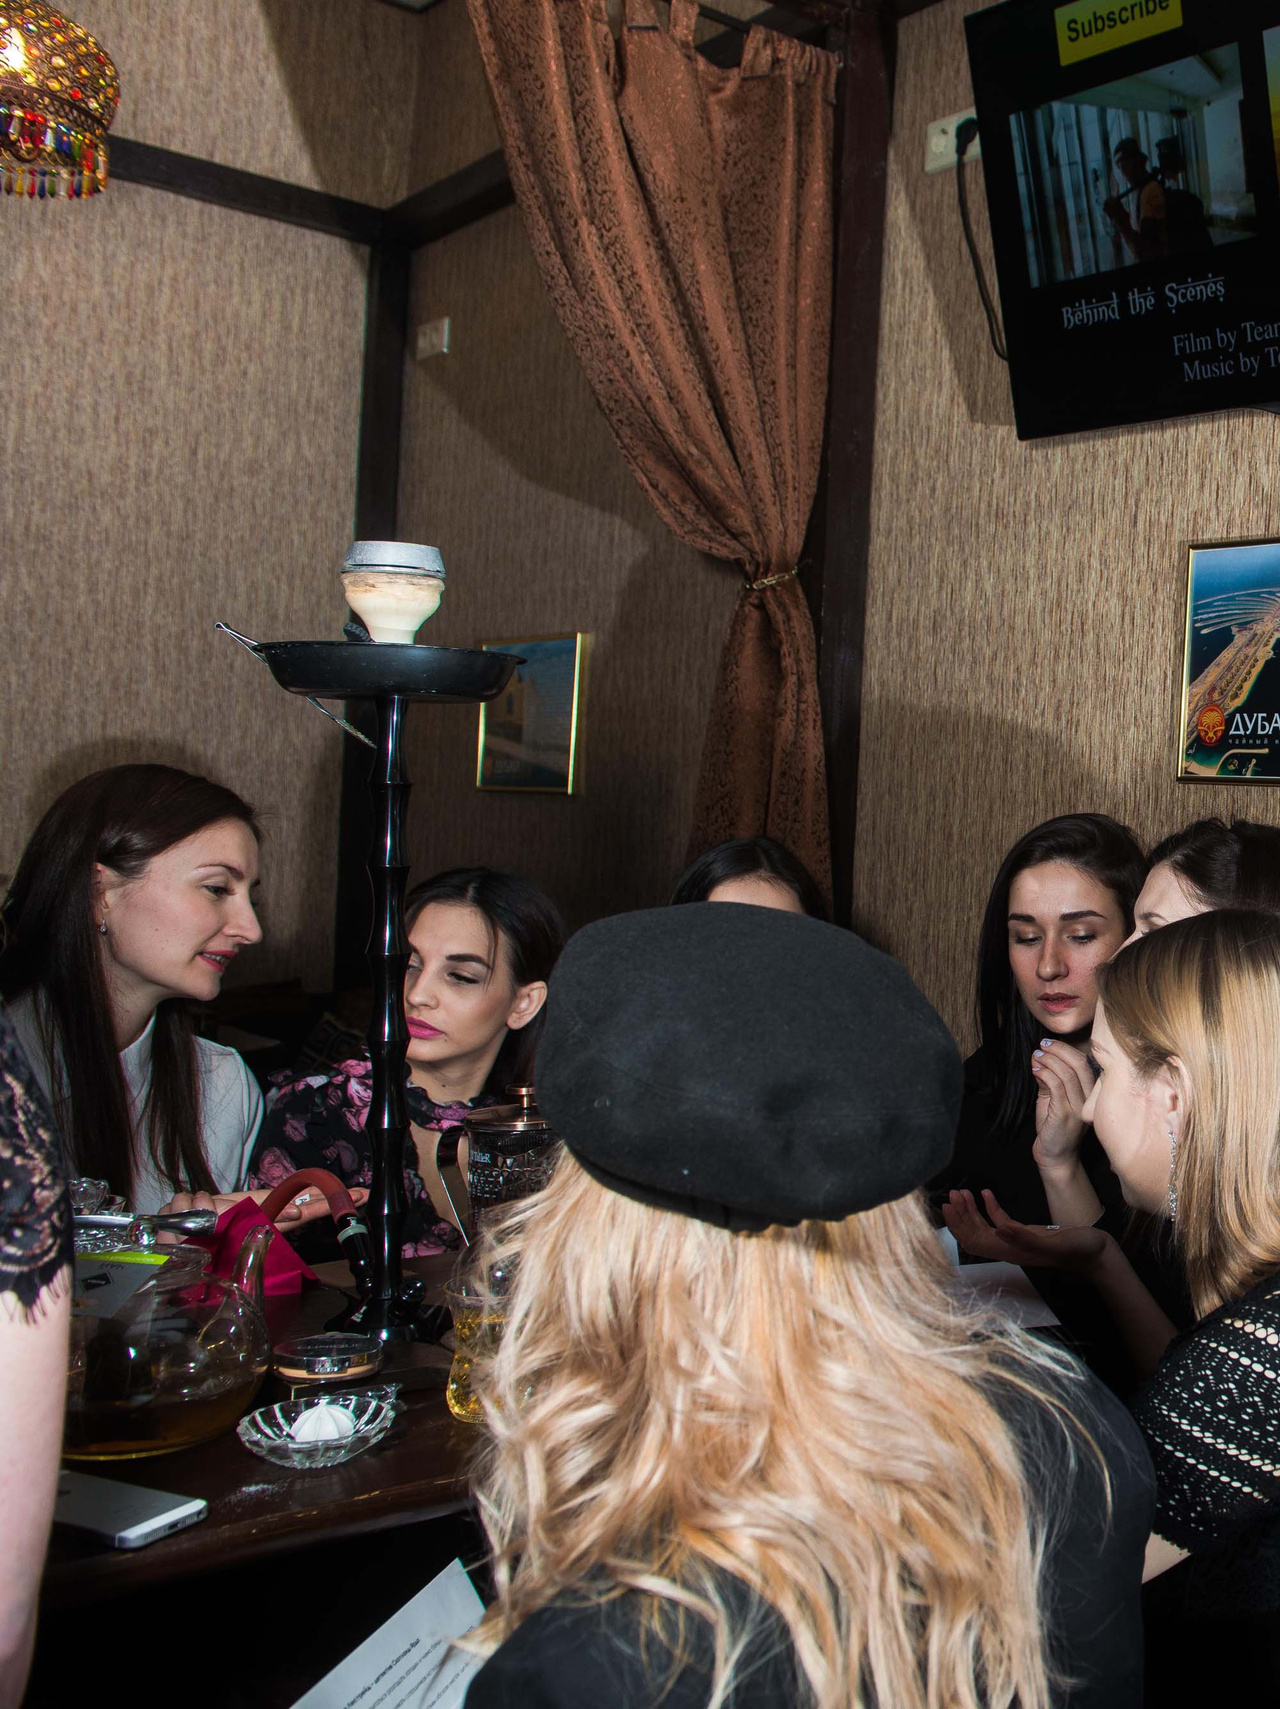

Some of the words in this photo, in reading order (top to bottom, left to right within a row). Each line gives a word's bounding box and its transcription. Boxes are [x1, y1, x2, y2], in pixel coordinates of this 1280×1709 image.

[1066, 0, 1170, 42] Subscribe
[1062, 291, 1120, 329] Behind
[1128, 286, 1155, 315] the
[1165, 272, 1225, 314] Scenes
[1173, 332, 1212, 356] Film
[1216, 328, 1237, 352] by
[1183, 356, 1234, 382] Music
[1239, 352, 1260, 377] by
